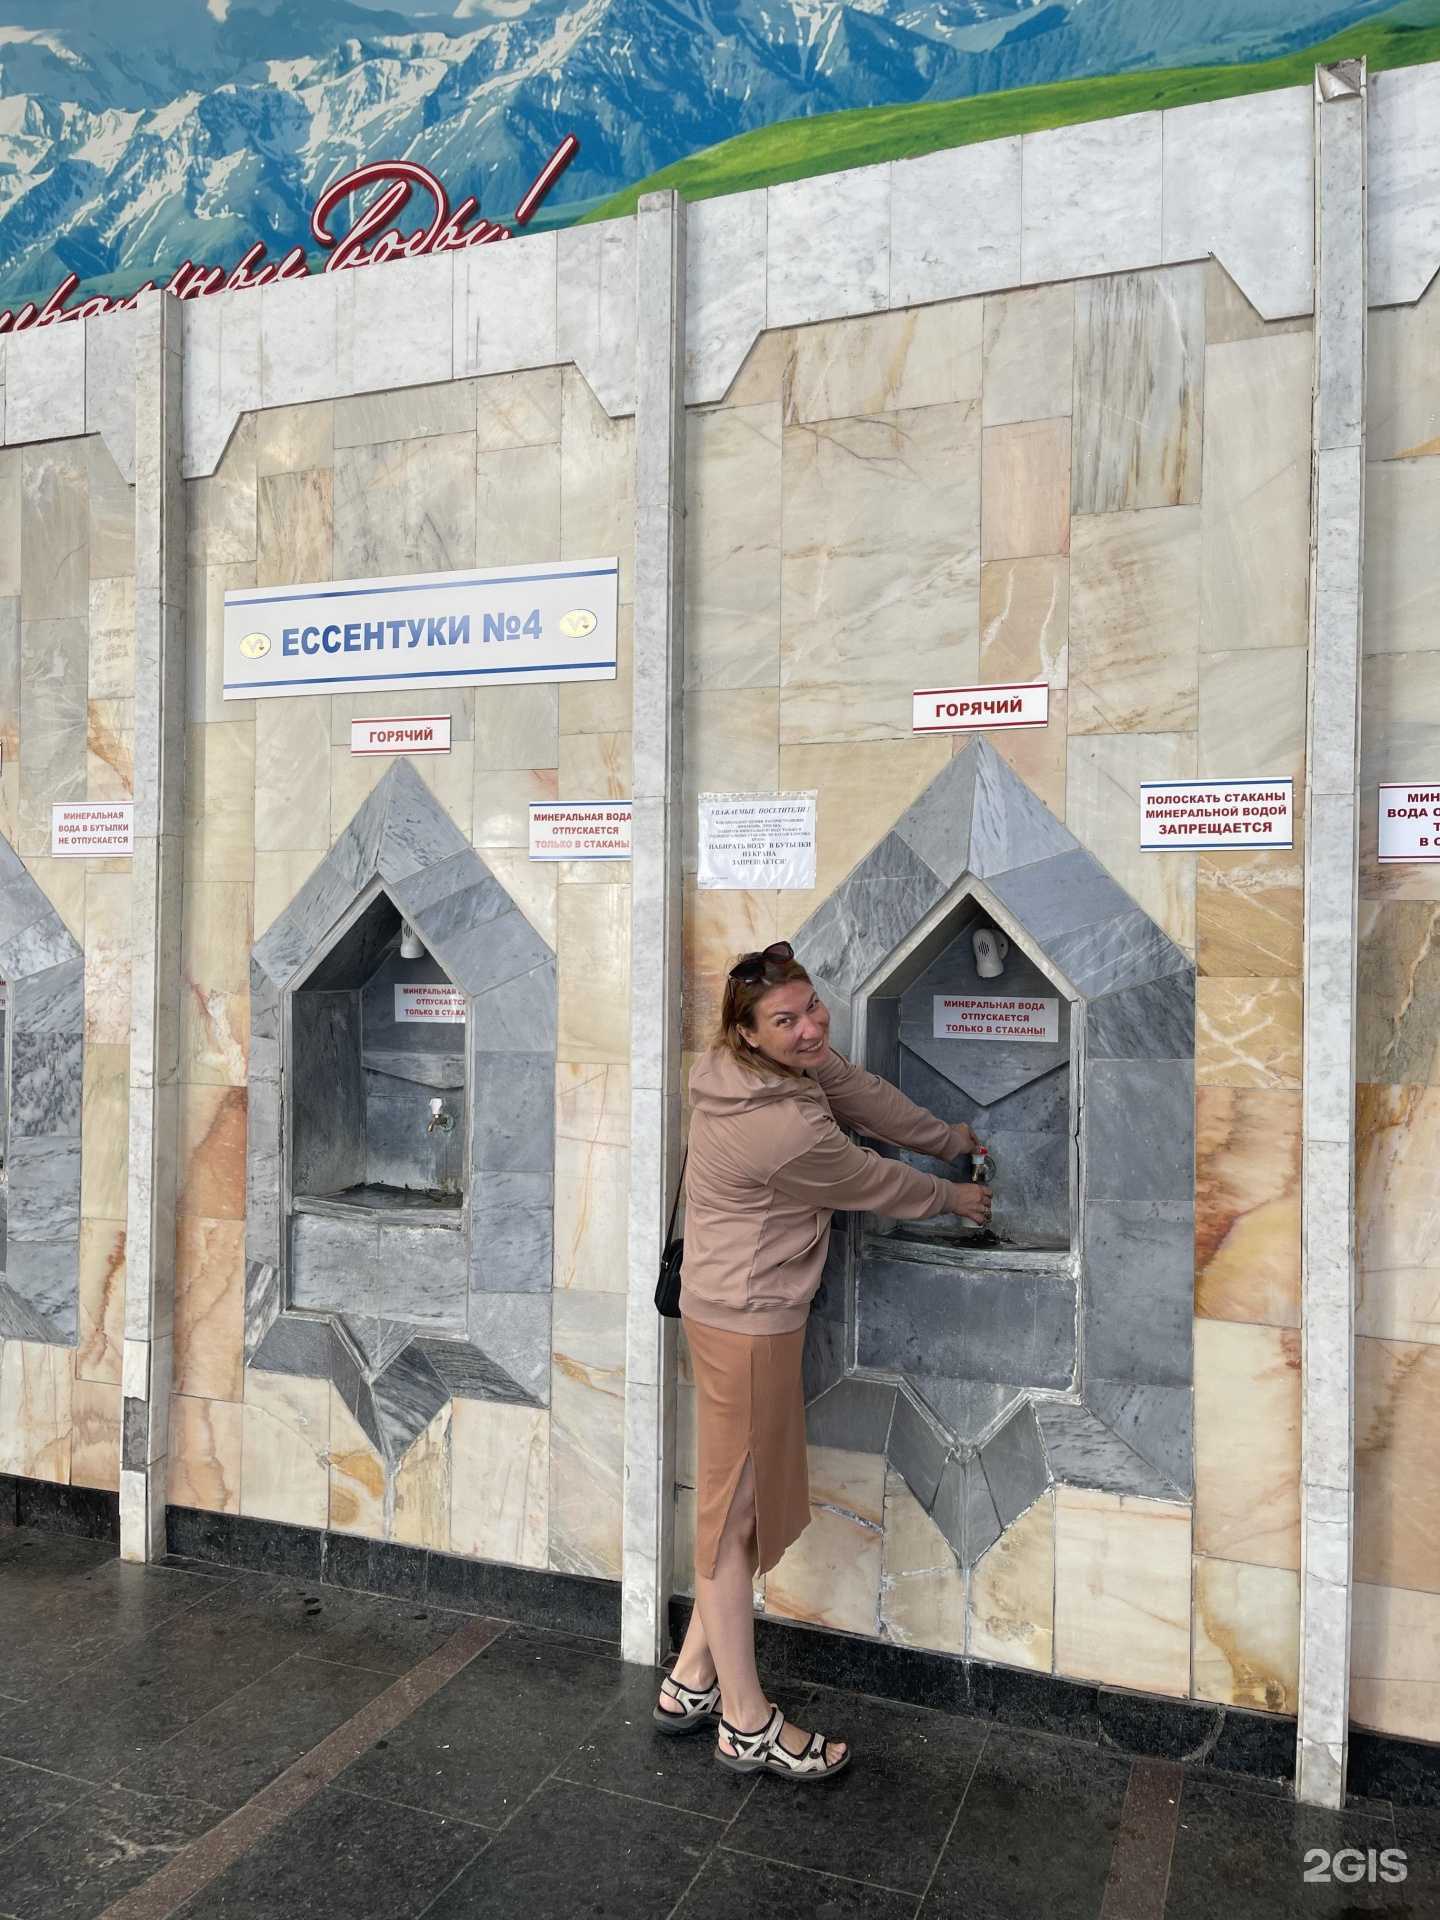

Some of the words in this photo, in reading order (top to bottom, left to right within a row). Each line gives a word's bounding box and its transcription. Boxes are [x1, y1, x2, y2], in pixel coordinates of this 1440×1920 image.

[282, 615, 470, 656] ЕССЕНТУКИ
[482, 608, 543, 643] №4
[936, 695, 1022, 717] ГОРЯЧИЙ
[369, 726, 433, 743] ГОРЯЧИЙ
[1147, 794, 1221, 805] ПОЛОСКАТЬ
[1224, 792, 1286, 802] СТАКАНЫ
[64, 812, 124, 820] МИНЕРАЛЬНАЯ
[1146, 807, 1239, 818] МИНЕРАЛЬНОЙ
[1242, 804, 1287, 817] ВОДОЙ
[1387, 808, 1428, 819] ВОДА
[533, 813, 604, 822] МИНЕРАЛЬНАЯ
[606, 812, 632, 822] ВОДА
[552, 826, 619, 835] ОТПУСКАЕТСЯ
[1158, 822, 1273, 835] ЗАПРЕЩАЕТСЯ
[71, 836, 129, 844] ОТПУСКАЕТСЯ
[536, 840, 572, 848] ТОЛЬКО
[575, 840, 581, 848] В
[1419, 837, 1429, 846] В
[944, 1001, 1015, 1010] МИНЕРАЛЬНАЯ
[1018, 1002, 1045, 1011] ВОДА
[961, 1013, 1030, 1022] ОТПУСКАЕТСЯ
[946, 1024, 984, 1033] ТОЛЬКО
[995, 1026, 1046, 1035] СТАКАНЫ!
